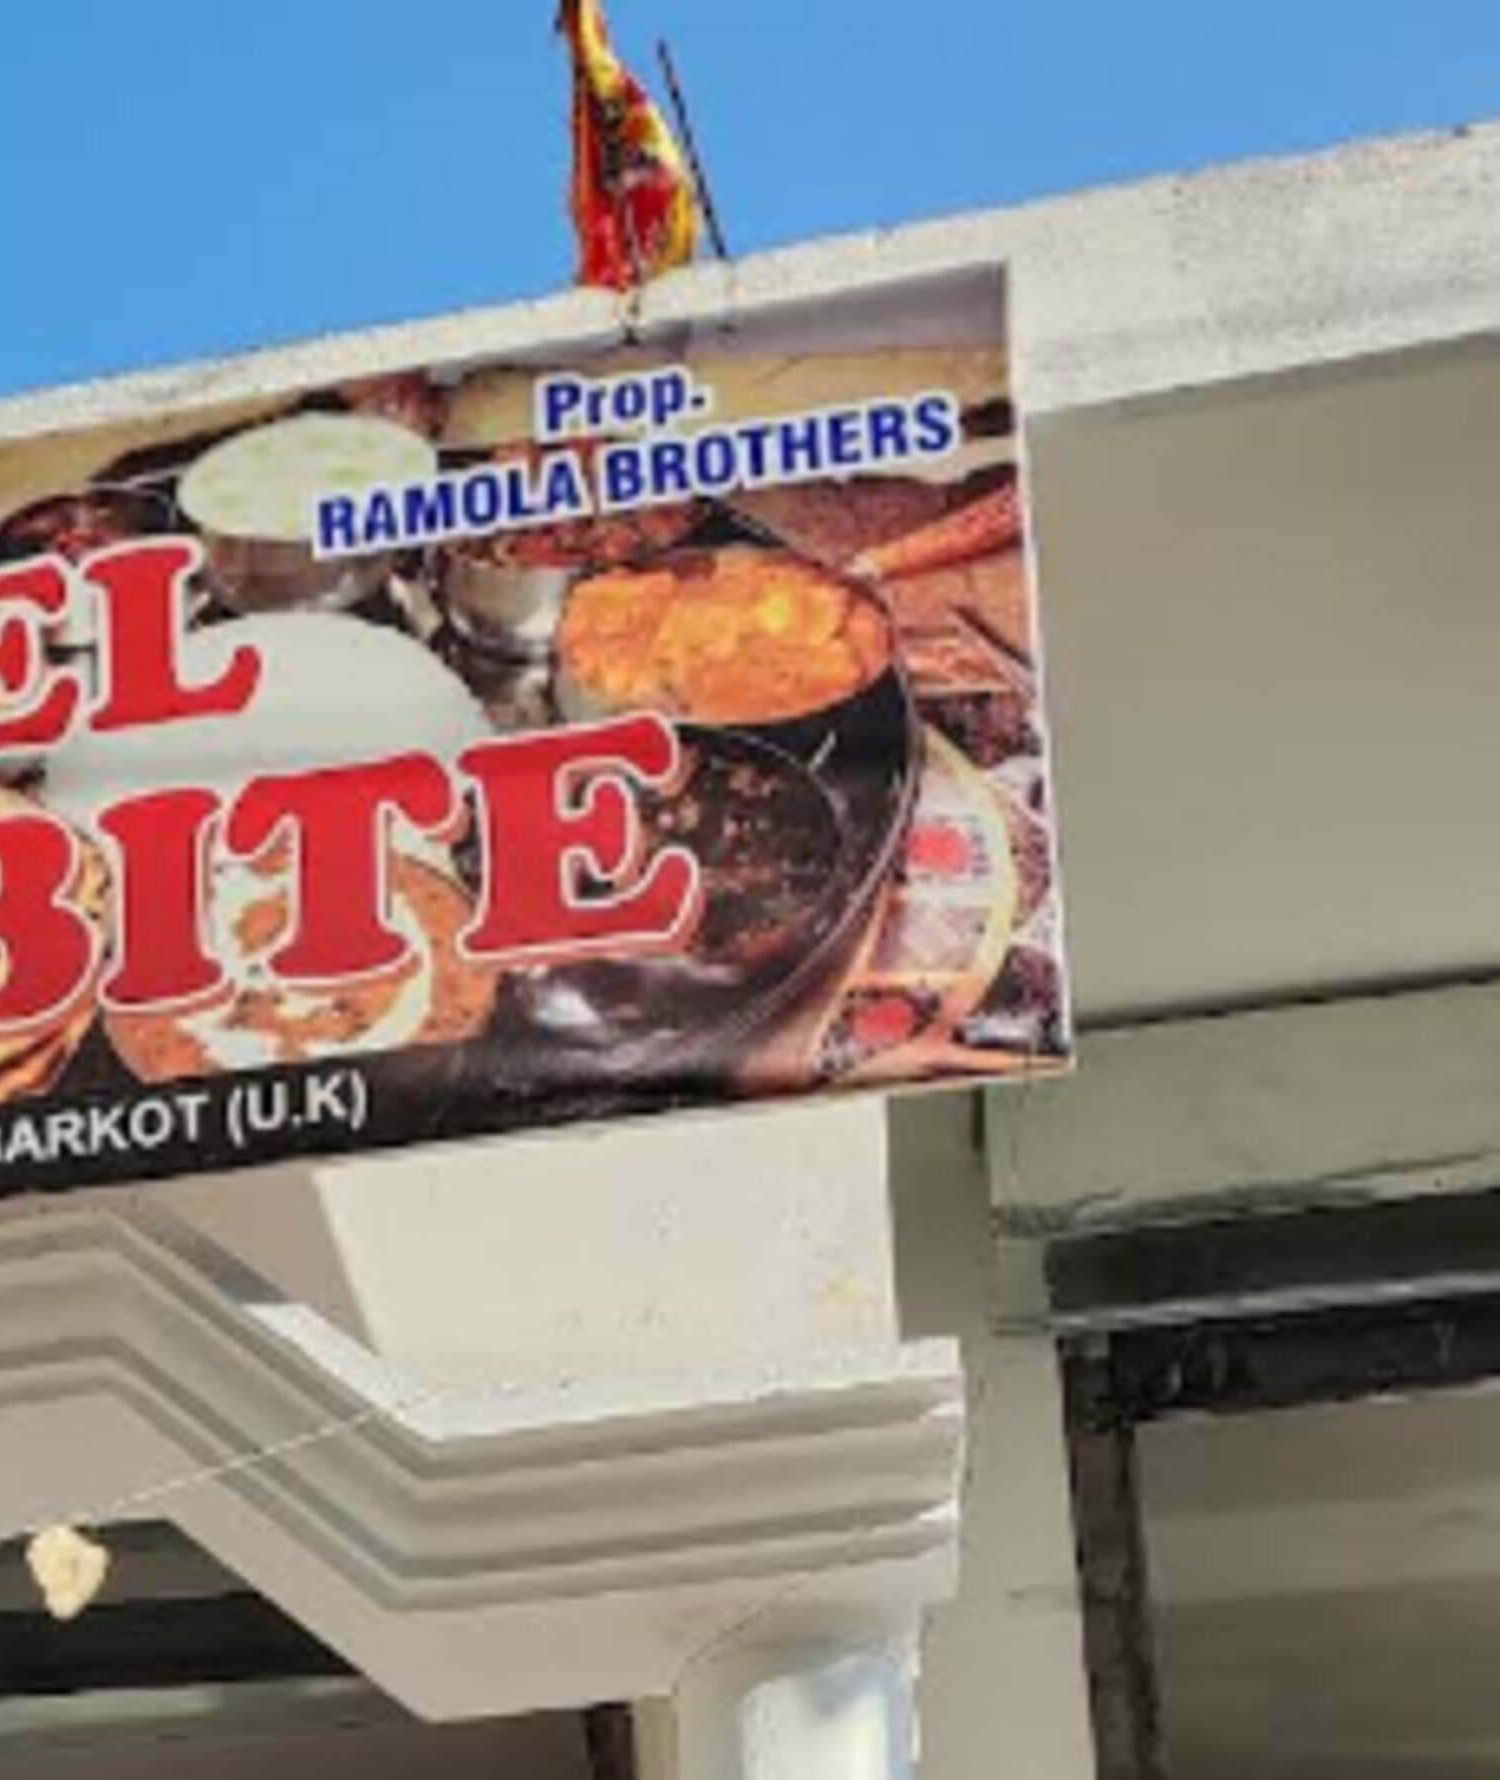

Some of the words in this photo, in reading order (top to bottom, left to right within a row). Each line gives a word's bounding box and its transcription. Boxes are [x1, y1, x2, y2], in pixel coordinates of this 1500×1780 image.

[543, 371, 705, 431] Prop.
[318, 459, 582, 549] RAMOLA
[606, 398, 955, 503] BROTHERS
[226, 1070, 368, 1149] (U.K)
